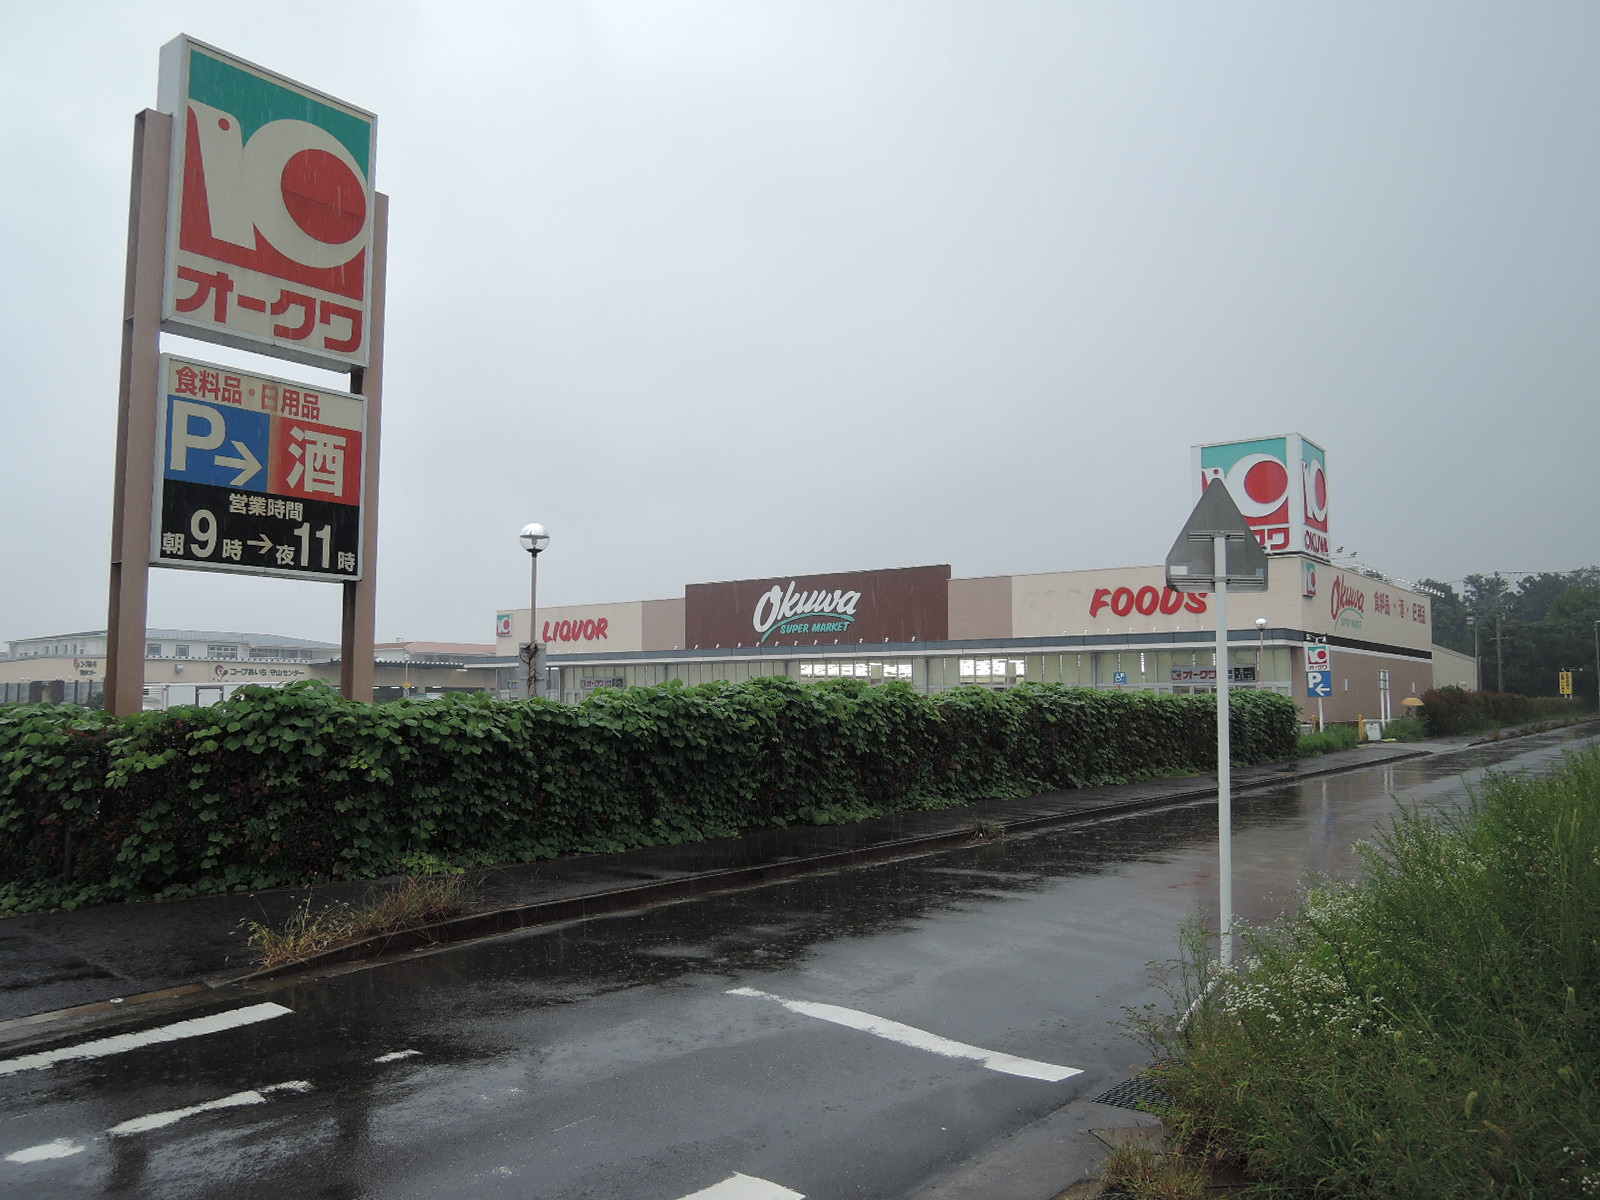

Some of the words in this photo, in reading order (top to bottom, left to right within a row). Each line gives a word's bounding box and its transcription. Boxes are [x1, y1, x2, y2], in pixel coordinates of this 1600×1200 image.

[176, 264, 363, 353] オークワ
[175, 365, 321, 421] 食料品・日用品
[170, 399, 226, 472] P
[286, 426, 348, 498] 酒
[229, 493, 303, 521] 営業時間
[752, 580, 862, 633] Okuwa
[1089, 585, 1208, 618] FOODS
[1331, 574, 1365, 620] Okuwa
[542, 617, 609, 643] LIQUOR
[779, 623, 809, 635] SUPER
[811, 621, 851, 634] MARKET
[229, 667, 267, 677] コープあいち
[270, 668, 305, 677] 守山センター
[1307, 672, 1322, 688] P
